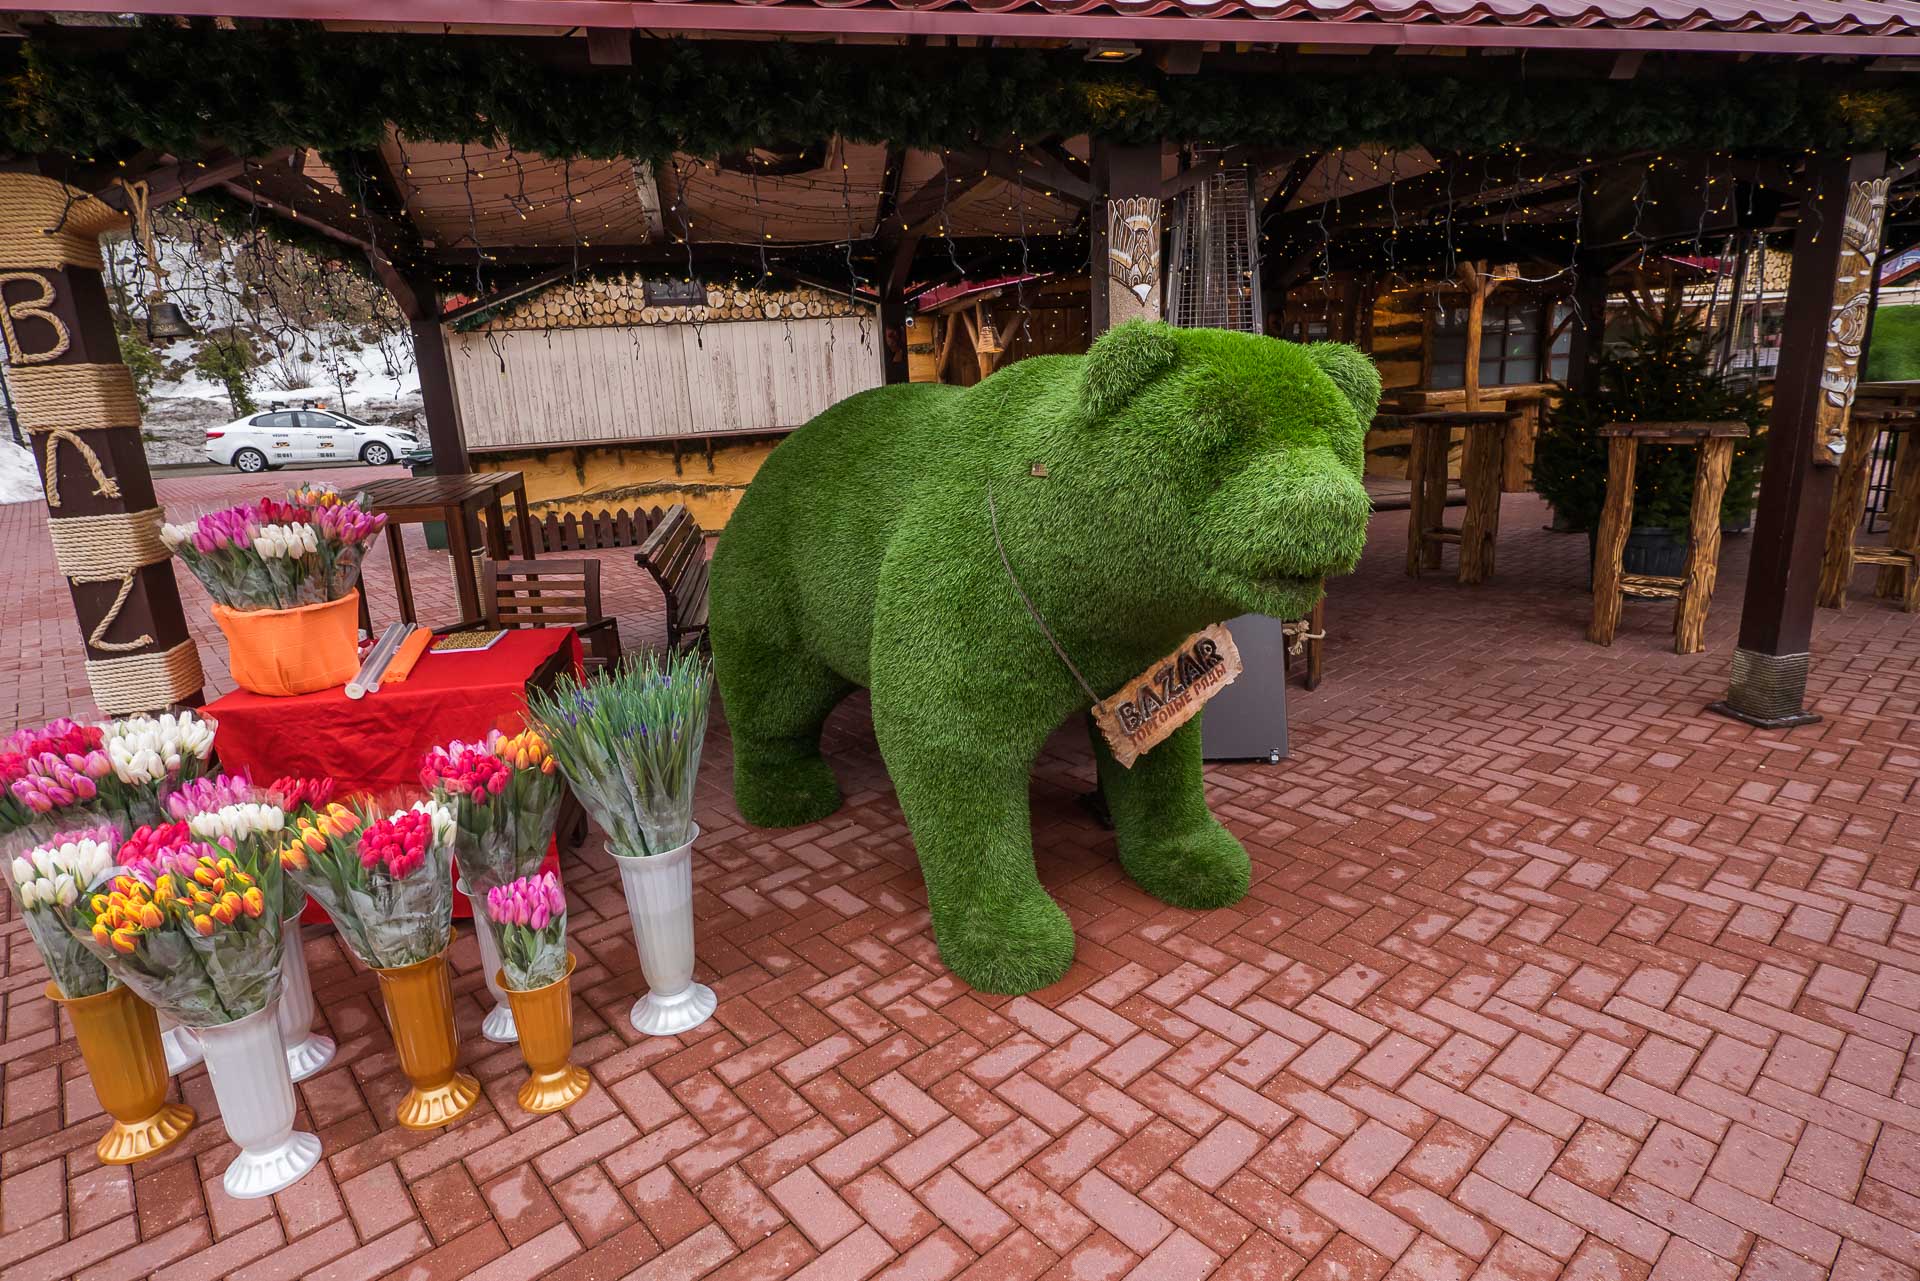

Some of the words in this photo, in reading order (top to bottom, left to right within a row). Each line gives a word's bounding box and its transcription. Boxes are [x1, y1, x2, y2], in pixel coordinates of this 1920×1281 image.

[1115, 637, 1224, 735] BAZAR
[1127, 692, 1193, 747] ТОРГОВЫЕ
[1194, 663, 1227, 696] РЯДЫ
